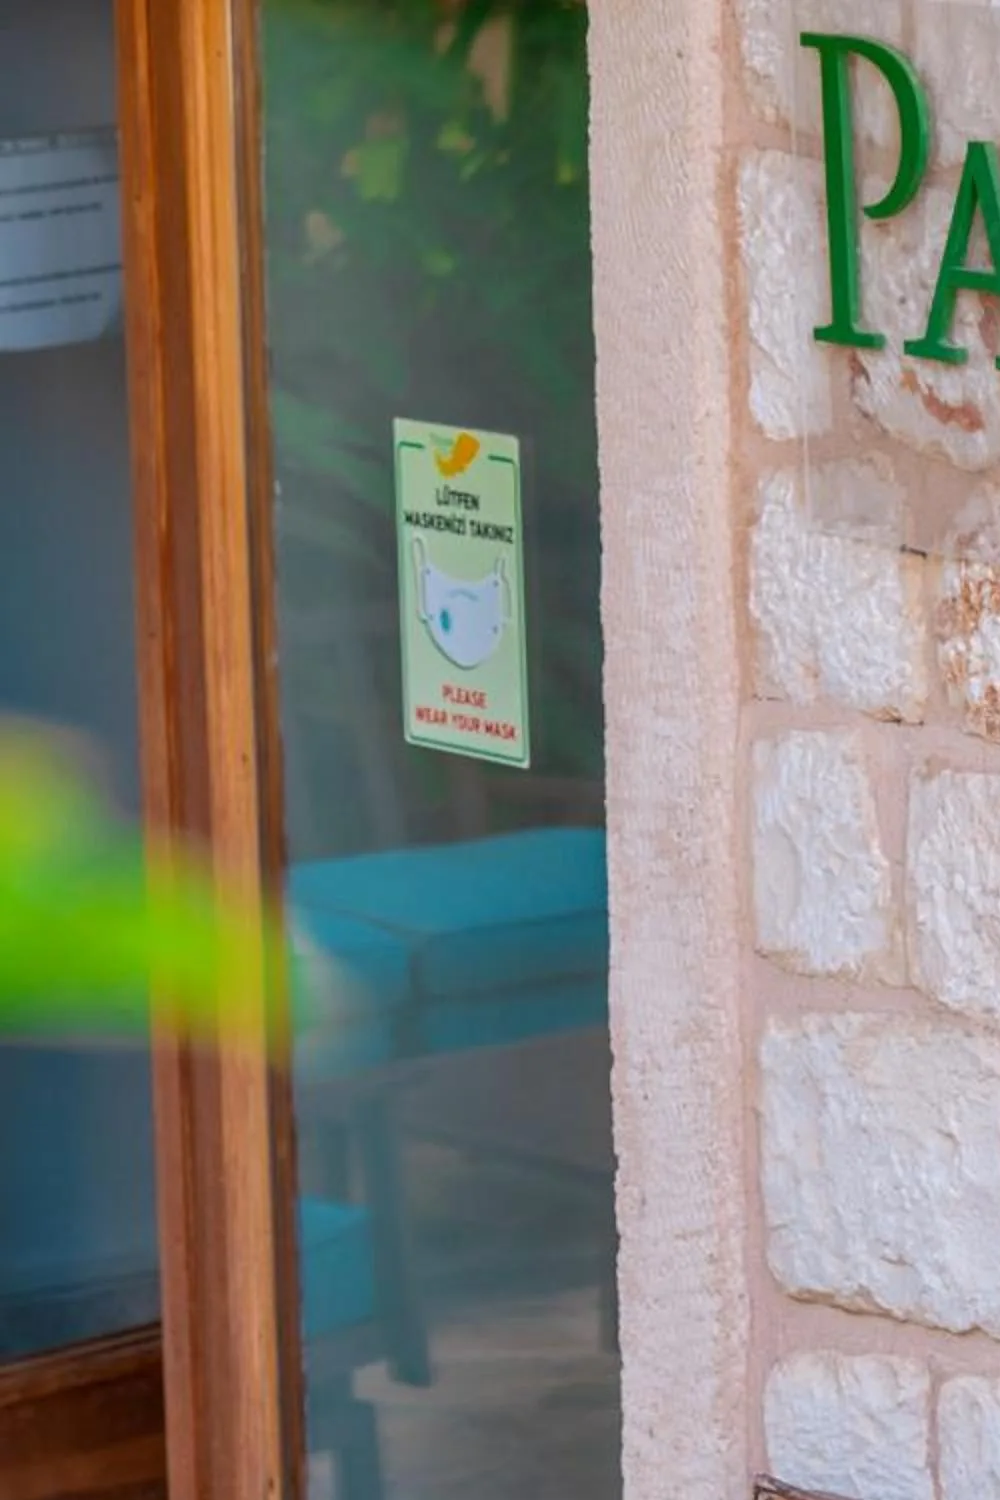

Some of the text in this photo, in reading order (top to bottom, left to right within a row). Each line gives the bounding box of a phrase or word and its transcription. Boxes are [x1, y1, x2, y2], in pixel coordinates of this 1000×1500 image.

[435, 484, 481, 512] LÜTFEN
[469, 519, 514, 545] TAKINIZ
[441, 684, 488, 710] PLEASE
[415, 706, 517, 741] WEAR YOUR MASK
